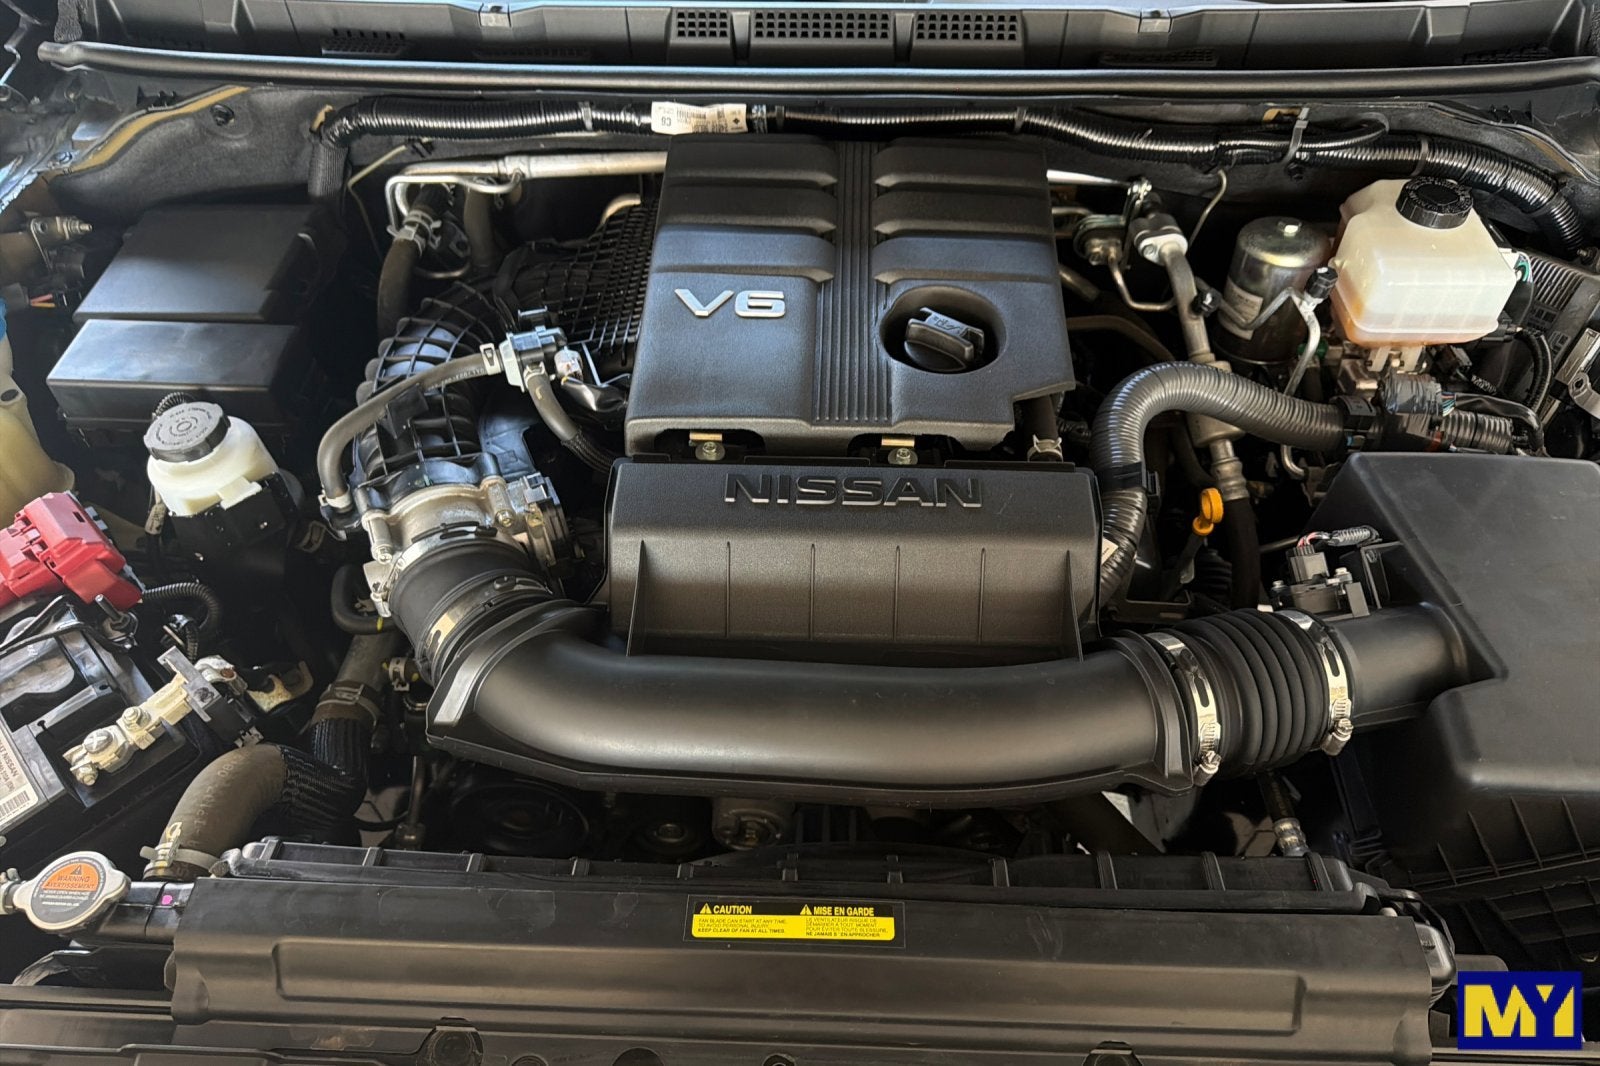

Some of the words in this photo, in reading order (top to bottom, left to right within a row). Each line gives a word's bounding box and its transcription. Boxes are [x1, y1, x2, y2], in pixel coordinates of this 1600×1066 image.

[674, 288, 786, 318] V6
[724, 473, 982, 508] NISSAN
[713, 905, 752, 914] CAUTION
[814, 906, 832, 916] MISE
[834, 906, 845, 916] EN
[847, 907, 874, 917] GARDE
